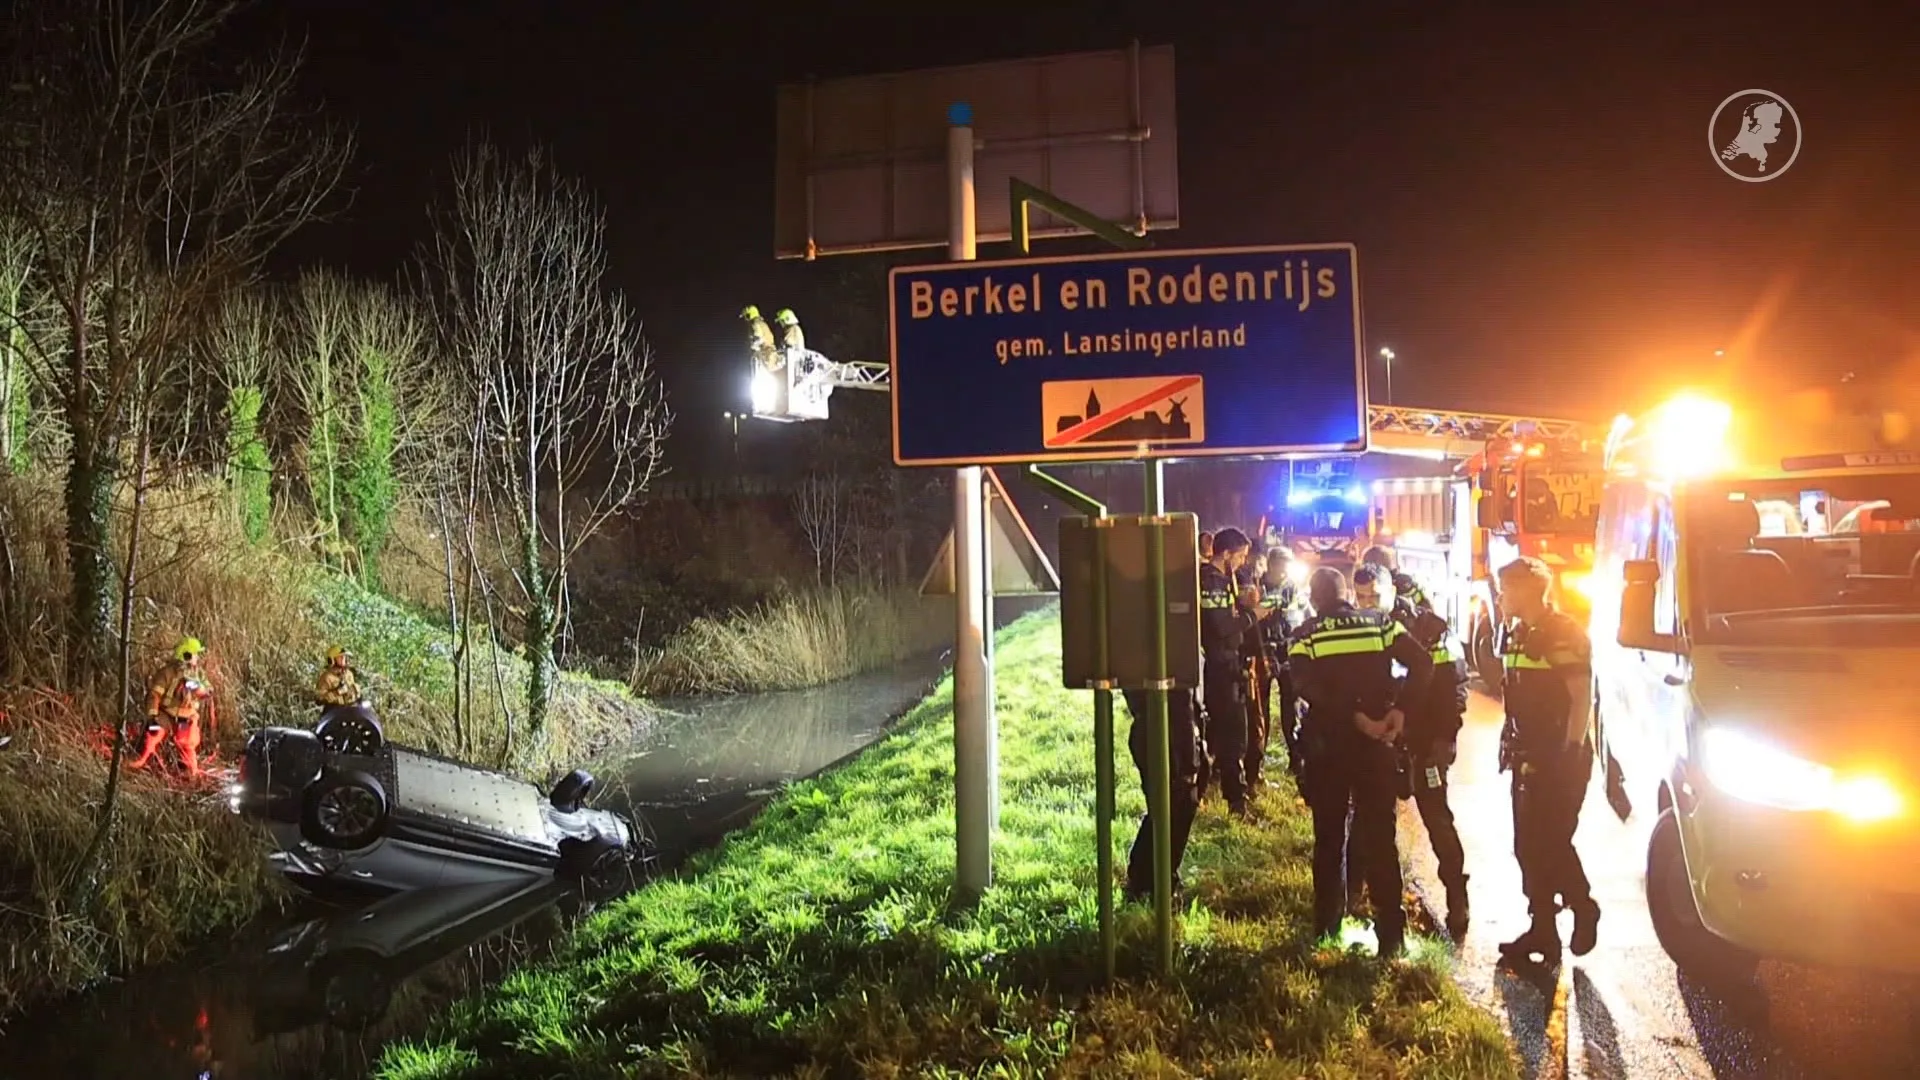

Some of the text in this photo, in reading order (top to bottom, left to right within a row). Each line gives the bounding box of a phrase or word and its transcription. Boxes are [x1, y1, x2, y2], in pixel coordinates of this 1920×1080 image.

[911, 260, 1336, 318] Berkel en Rodenrijs
[996, 323, 1246, 365] gem. Lansingerland
